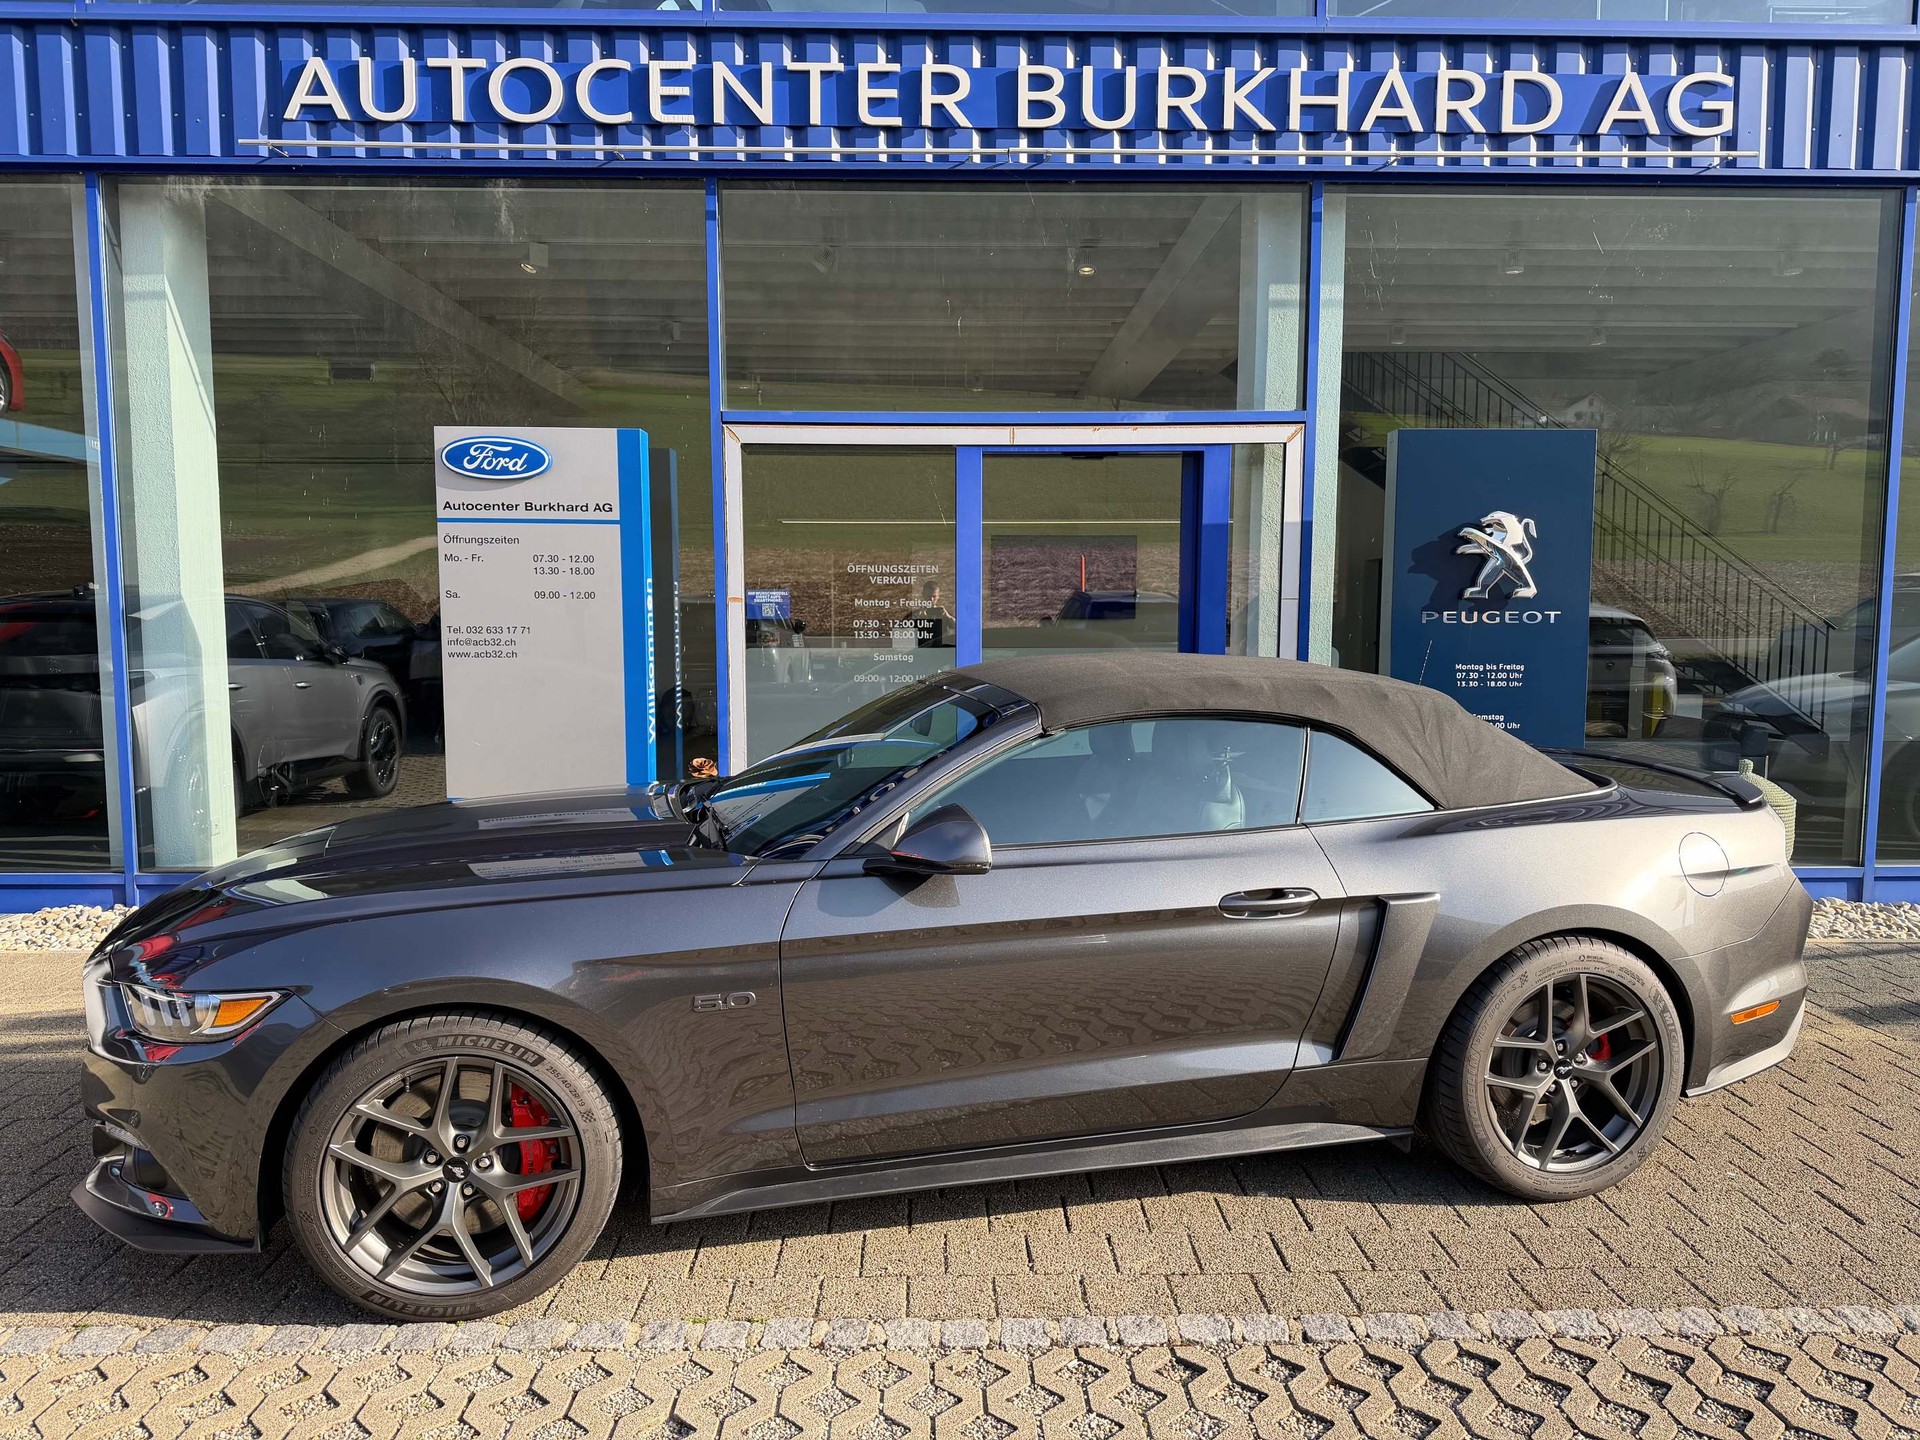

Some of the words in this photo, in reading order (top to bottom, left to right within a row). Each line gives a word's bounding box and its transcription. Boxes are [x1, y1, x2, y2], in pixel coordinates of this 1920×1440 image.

[283, 56, 974, 128] AUTOCENTER
[1017, 64, 1564, 134] BURKHARD
[1598, 71, 1735, 137] AG
[463, 443, 529, 472] Ford
[442, 501, 520, 513] Autocenter
[524, 501, 589, 514] Burkhard
[593, 503, 613, 514] AG
[443, 534, 520, 546] Öffnungszeiten
[444, 553, 463, 563] Mo.
[471, 554, 484, 563] Fr.
[532, 554, 560, 564] 07.30
[568, 554, 595, 564] 12.00
[533, 567, 560, 577] 13.30
[569, 567, 595, 577] 18.00
[847, 564, 939, 574] ÖFFNUNGSZEITEN
[870, 576, 917, 585] VERKAUF
[445, 590, 461, 600] Sa.
[534, 591, 561, 601] 09.00
[569, 591, 596, 601] 12.00
[854, 599, 889, 608] Montag
[900, 598, 932, 608] Freitag
[1421, 611, 1562, 624] PEUGEOT
[853, 620, 879, 628] 07:30
[889, 620, 914, 628] 12:00
[917, 620, 934, 628] Uhr
[446, 626, 464, 636] Tel.
[465, 626, 484, 636] 032
[486, 626, 504, 636] 633
[506, 626, 518, 636] 17
[520, 626, 531, 636] 71
[854, 631, 879, 639] 13:30
[889, 631, 914, 639] 18:00
[917, 631, 934, 639] Uhr
[447, 638, 517, 649] info@acb32.ch
[447, 650, 518, 660] www.acb32.ch
[873, 653, 914, 663] Samstag
[646, 577, 656, 745] Willkommen
[854, 675, 879, 683] 09:00
[889, 675, 914, 683] 12:00
[691, 991, 756, 1012] 5.0
[1475, 1014, 1490, 1046] PILOT
[1488, 991, 1508, 1019] SPORT
[436, 1035, 540, 1064] MICHELIN
[1662, 1011, 1680, 1096] MICHELIN
[546, 1065, 572, 1088] 255/40
[569, 1088, 580, 1099] ZR
[577, 1098, 586, 1107] 19
[1466, 1053, 1486, 1142] MICHELIN
[370, 1292, 472, 1317] MICHELIN
